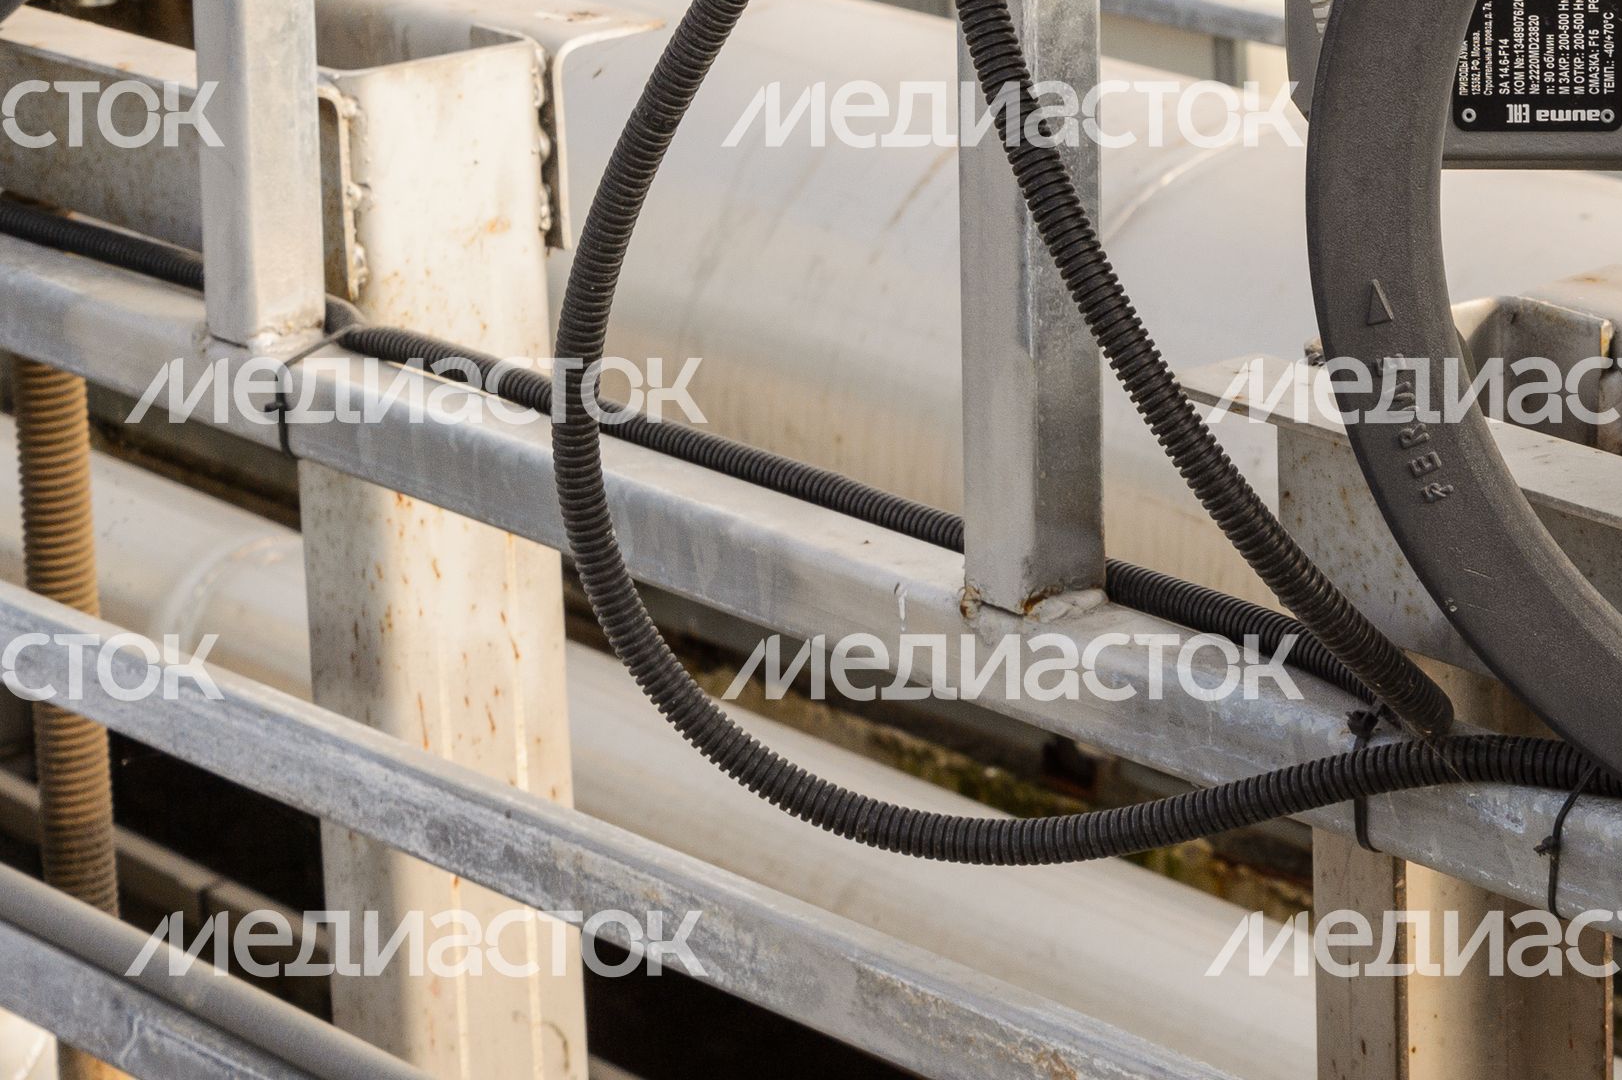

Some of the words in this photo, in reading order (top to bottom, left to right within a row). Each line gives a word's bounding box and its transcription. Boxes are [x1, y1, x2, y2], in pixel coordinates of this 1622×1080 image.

[1559, 14, 1569, 50] 200-500
[1574, 14, 1584, 49] 200-500
[1589, 29, 1599, 46] F15
[1499, 38, 1509, 78] 14.6-F14
[1529, 15, 1539, 94] №:2220MD23820
[1545, 34, 1555, 68] об/мин
[1459, 61, 1468, 95] ПРИВОДЫ
[1485, 47, 1493, 95] Строительный
[1514, 72, 1525, 94] КОМ
[1545, 72, 1555, 82] 90
[1559, 53, 1569, 83] ЗАКР.:
[1574, 53, 1584, 83] ОТКР.:
[1589, 50, 1599, 94] СМАЗКА:
[1604, 61, 1615, 94] ТЕМП.:
[1500, 82, 1510, 94] SA
[1536, 108, 1600, 121] auma
